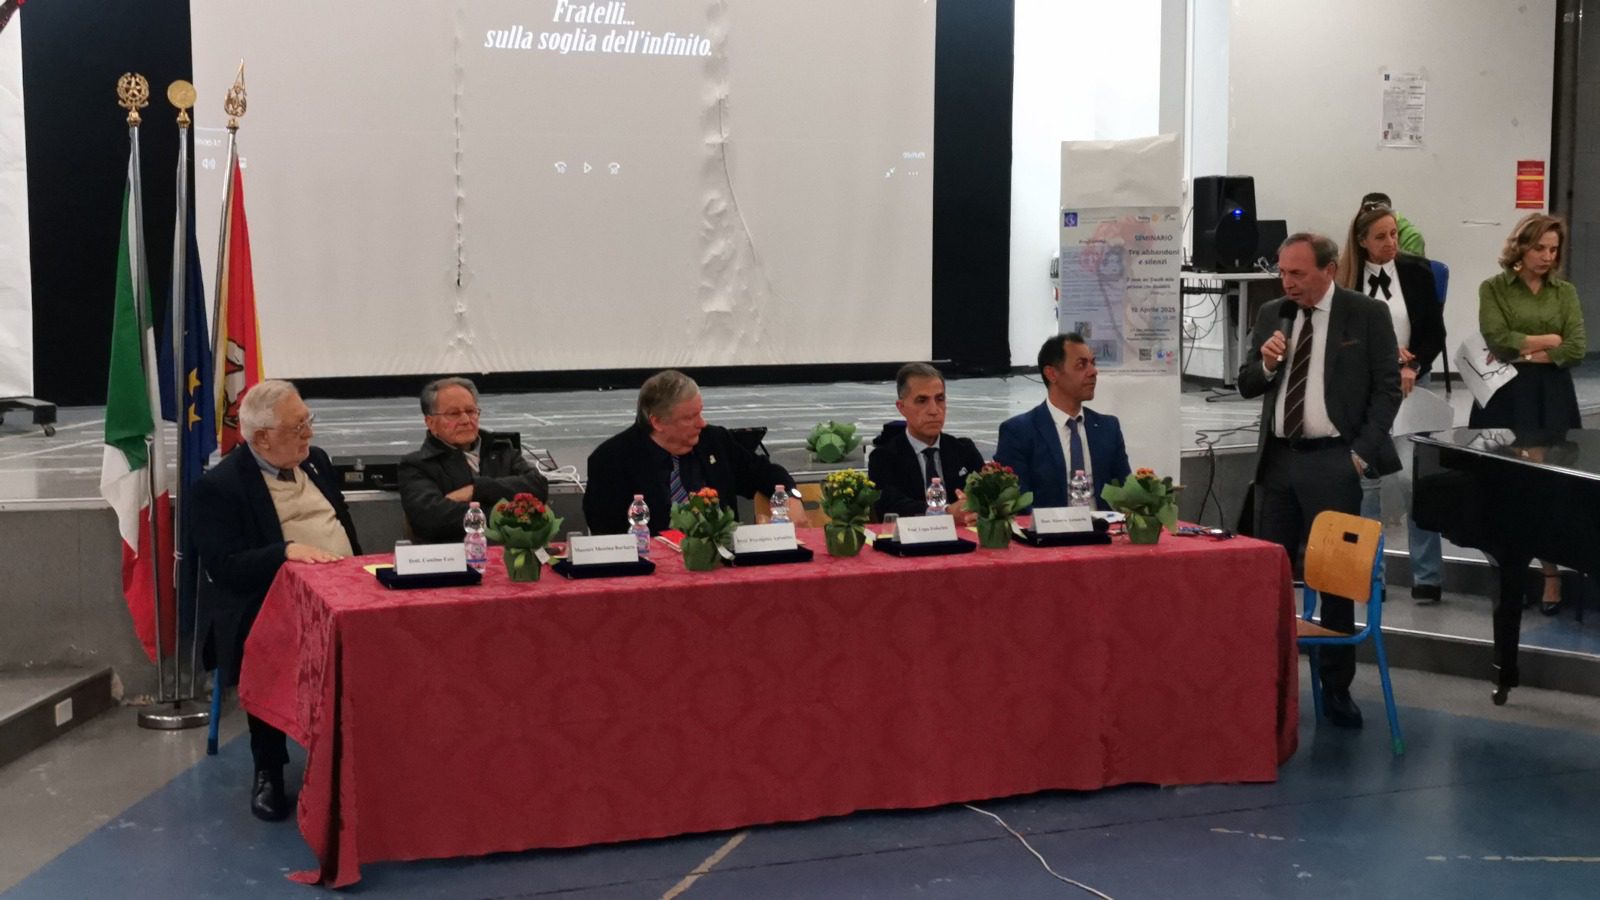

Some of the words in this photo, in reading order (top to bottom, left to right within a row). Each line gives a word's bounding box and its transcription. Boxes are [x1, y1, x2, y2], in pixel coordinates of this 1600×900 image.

[552, 0, 635, 25] Fratelli...
[484, 25, 533, 49] sulla
[538, 28, 597, 54] soglia
[601, 30, 713, 56] dell'infinito.
[1140, 306, 1159, 314] Aprile
